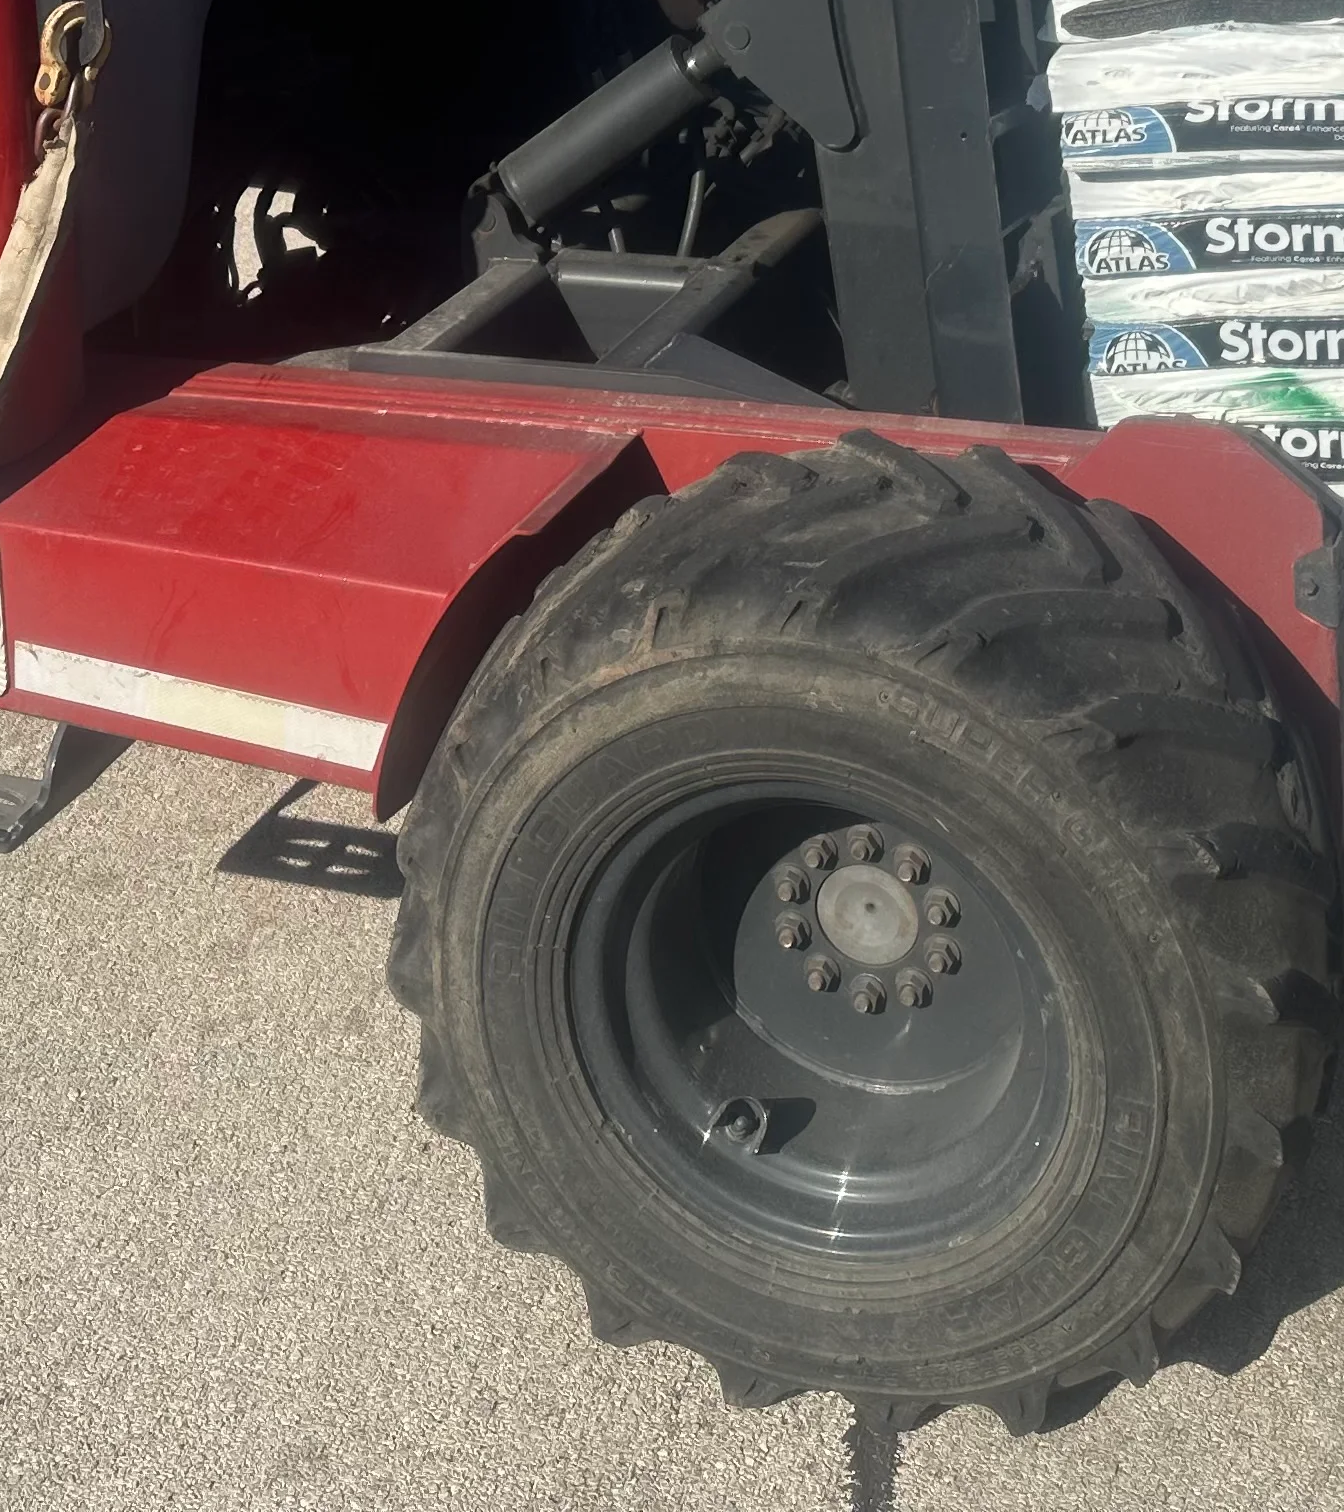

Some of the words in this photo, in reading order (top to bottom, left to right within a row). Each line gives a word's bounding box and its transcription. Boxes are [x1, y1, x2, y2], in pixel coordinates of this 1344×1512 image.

[1071, 127, 1145, 146] ATLAS
[1230, 125, 1271, 134] Featuring
[1096, 254, 1168, 273] ATLAS
